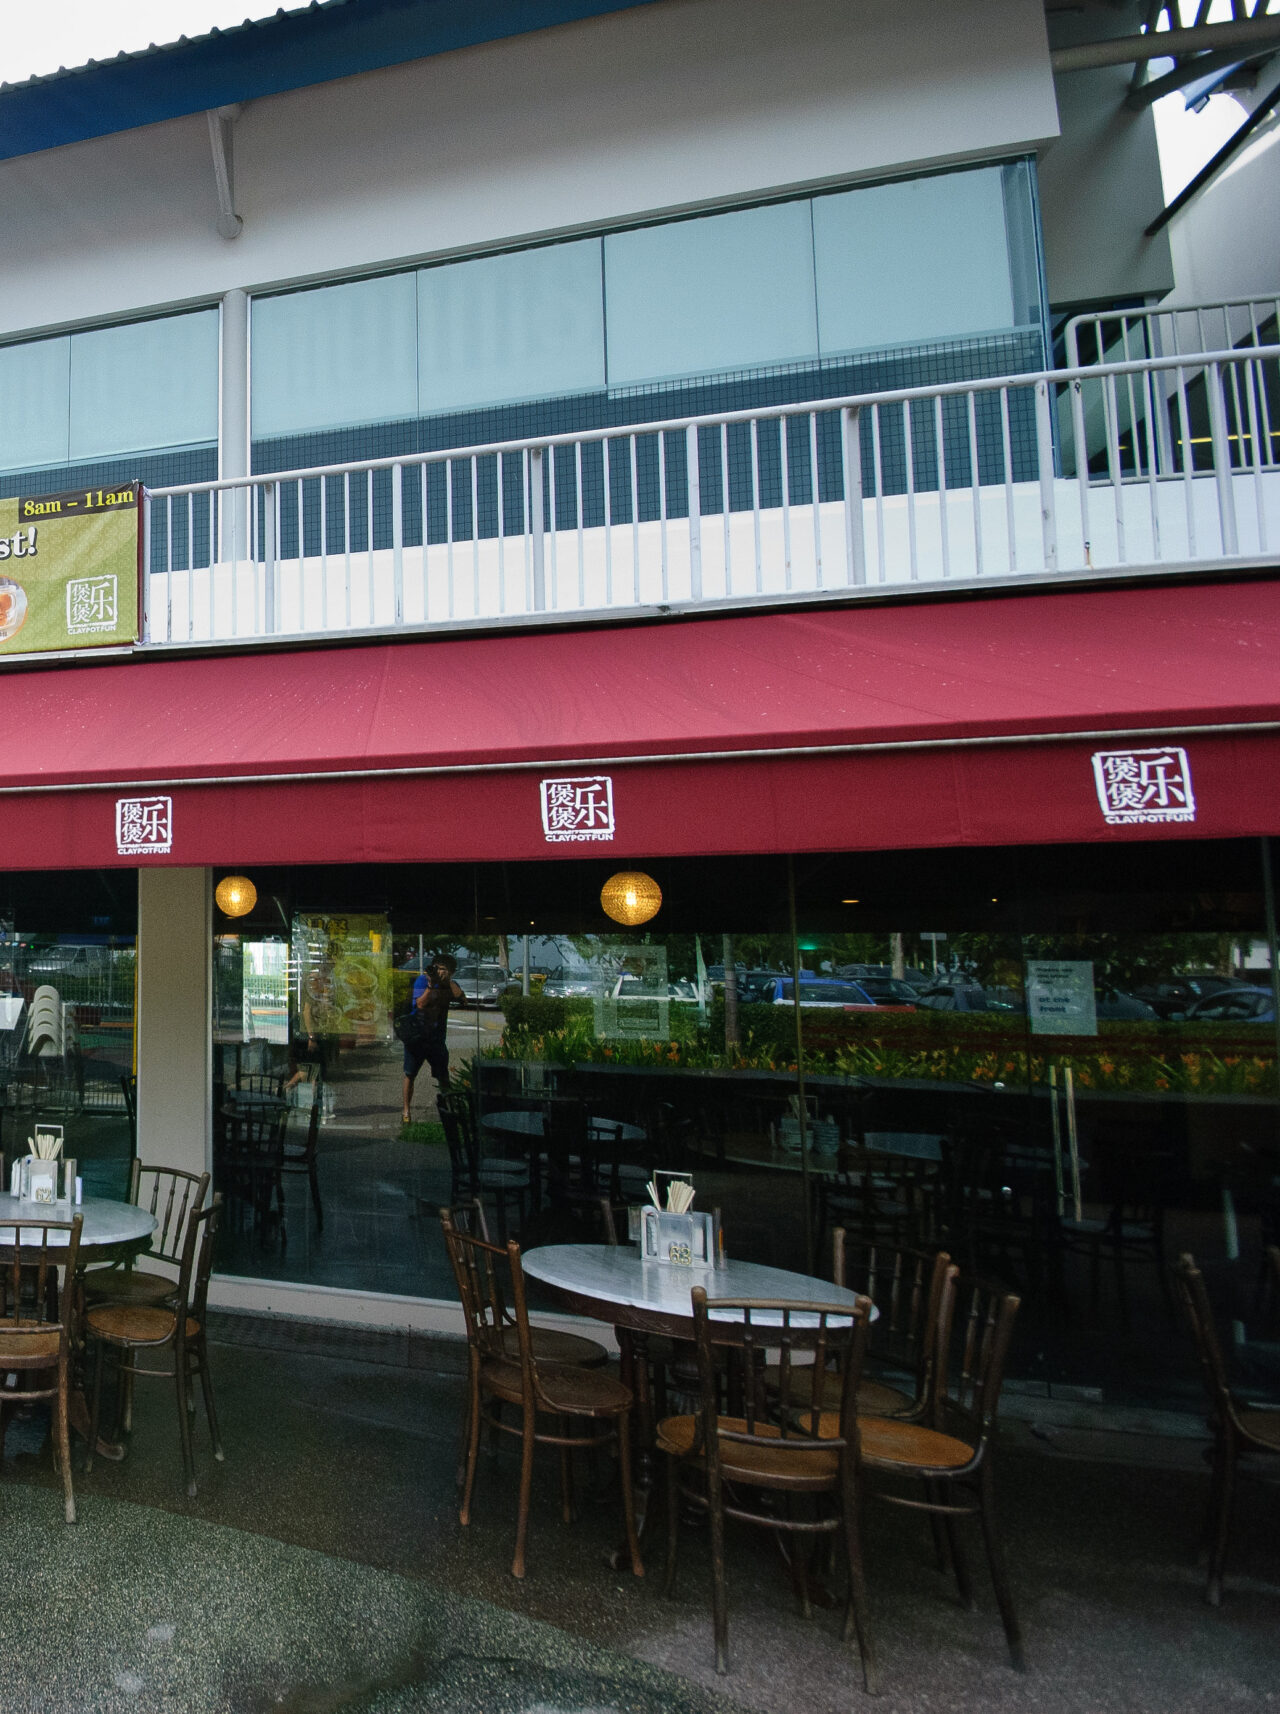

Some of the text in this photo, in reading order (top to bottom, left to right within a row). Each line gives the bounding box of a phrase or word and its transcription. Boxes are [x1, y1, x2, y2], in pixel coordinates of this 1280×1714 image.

[23, 499, 62, 516] 8am
[85, 489, 134, 508] 11am
[1105, 811, 1195, 824] CLAYPOTFUN
[545, 832, 614, 843] CLAYPOTFUN
[117, 846, 170, 855] CLAYPOTFUN
[669, 1245, 692, 1266] 63
